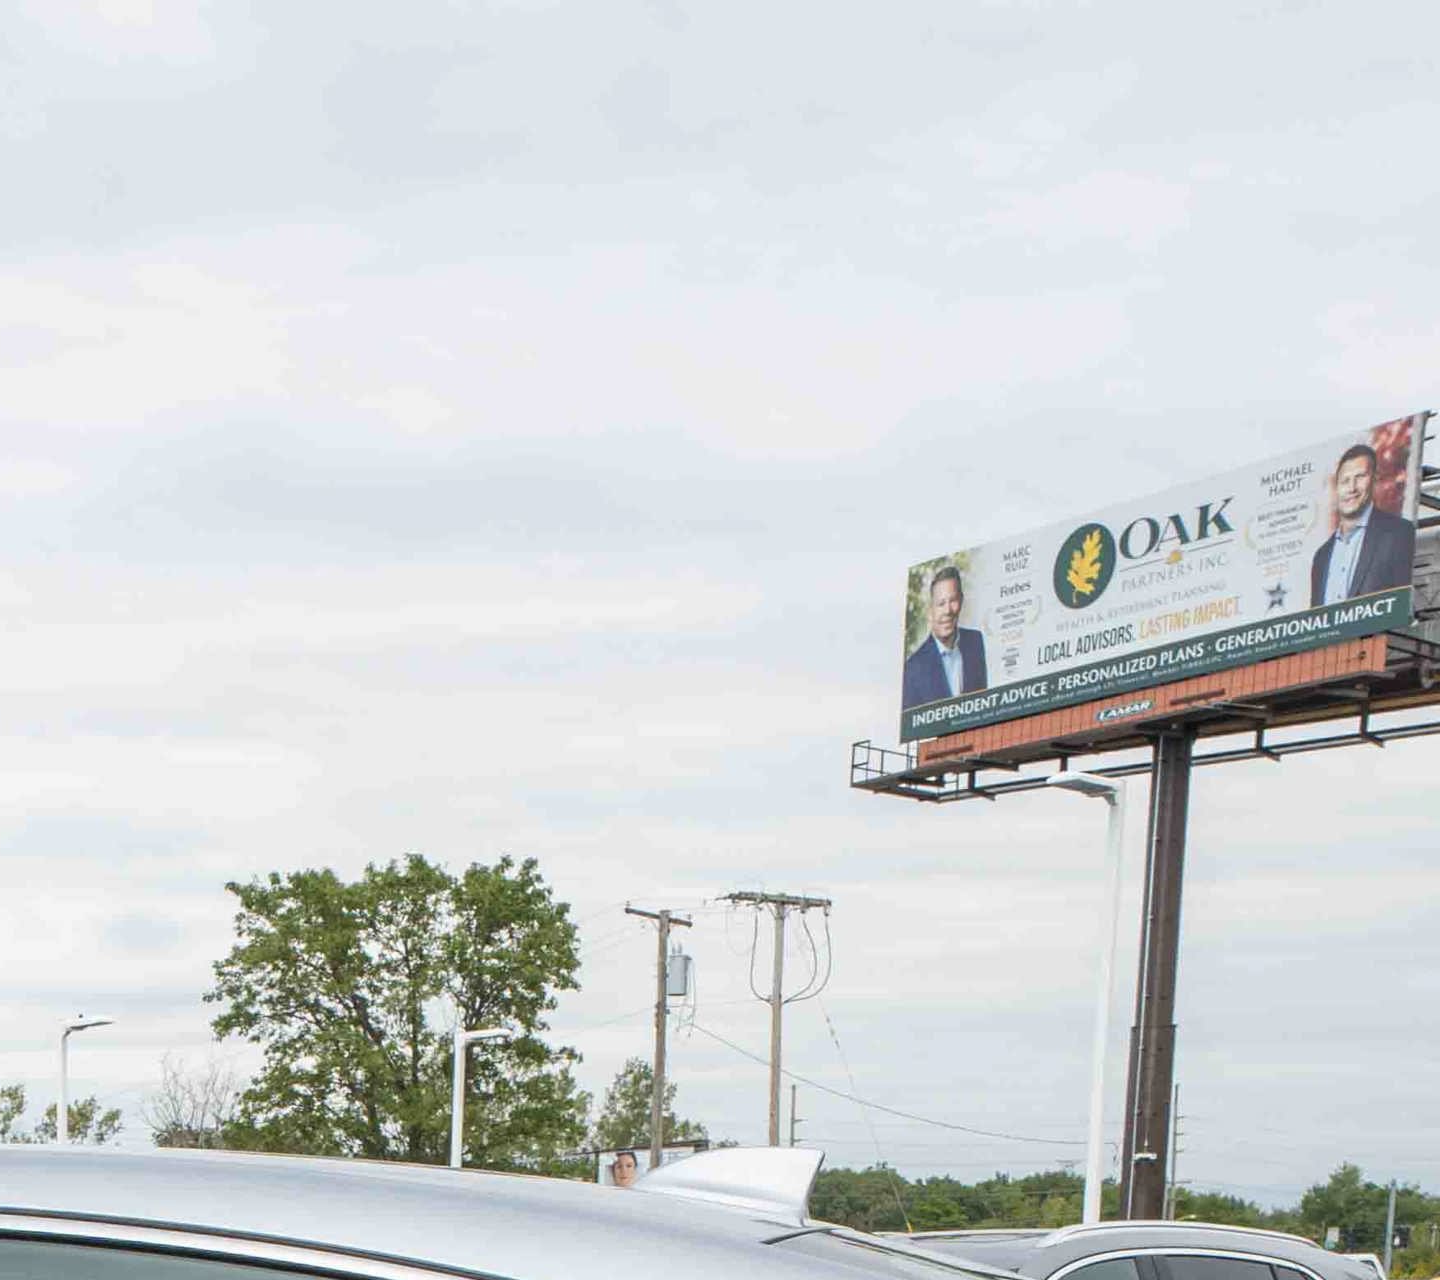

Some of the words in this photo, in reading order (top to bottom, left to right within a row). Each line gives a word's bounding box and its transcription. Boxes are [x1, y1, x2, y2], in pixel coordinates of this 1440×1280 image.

[1260, 462, 1315, 487] MICHAEL
[1268, 478, 1303, 497] HADT
[1119, 495, 1236, 560] OAK
[1002, 544, 1031, 562] MARC
[1004, 558, 1029, 573] RUIZ
[1121, 561, 1194, 593] PARTNERS
[1000, 581, 1032, 599] Forbes
[1037, 643, 1073, 665] LOCAL
[1138, 609, 1191, 640] LASTING
[912, 693, 1000, 729] INDEPENDENT
[999, 681, 1048, 706] ADVICE
[1057, 655, 1157, 691] PERSONALIZED
[1160, 642, 1204, 667] PLANS
[1215, 613, 1331, 654] GENERATIONAL
[1334, 597, 1397, 625] IMPACT
[1098, 701, 1152, 721] LAMAR
